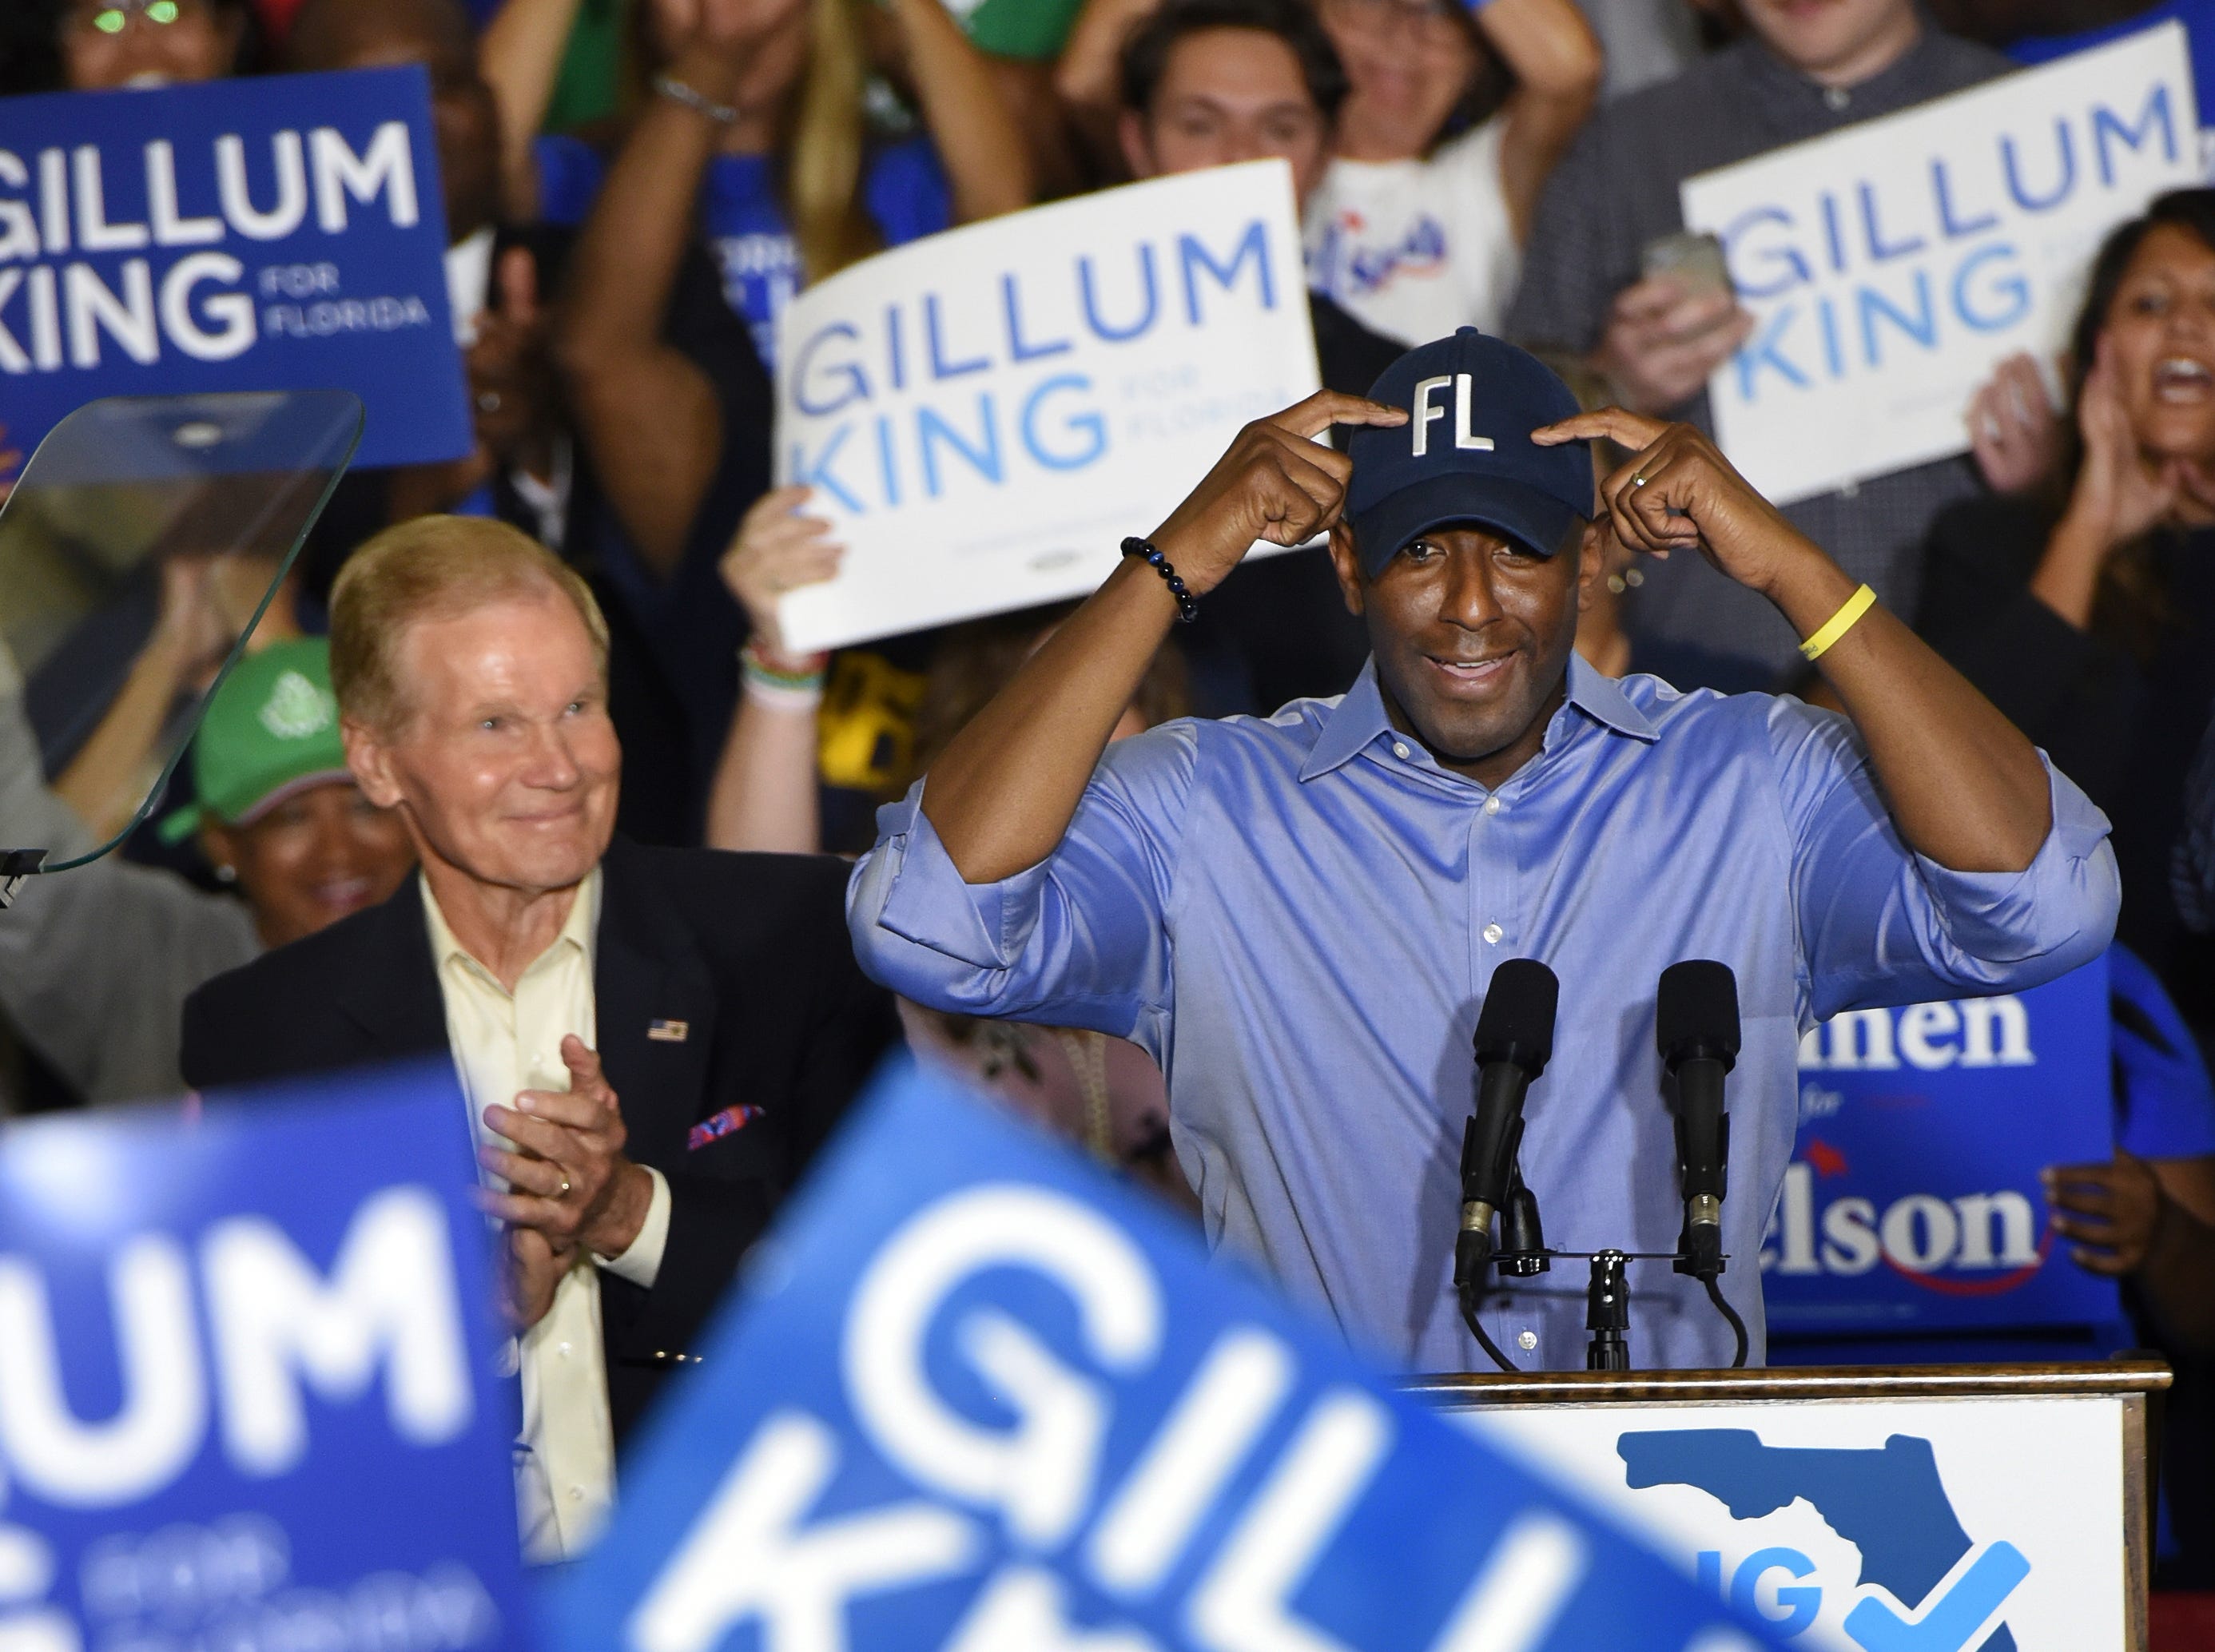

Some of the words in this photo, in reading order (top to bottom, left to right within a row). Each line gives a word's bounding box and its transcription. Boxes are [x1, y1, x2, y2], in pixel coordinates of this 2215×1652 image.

[1720, 81, 2178, 299] GILLUM
[258, 261, 340, 298] FOR
[263, 296, 432, 339] FLORIDA
[789, 216, 1278, 417] GILLUM
[1732, 242, 2032, 401] KING
[790, 373, 1108, 515] KING
[1412, 373, 1494, 457] FL
